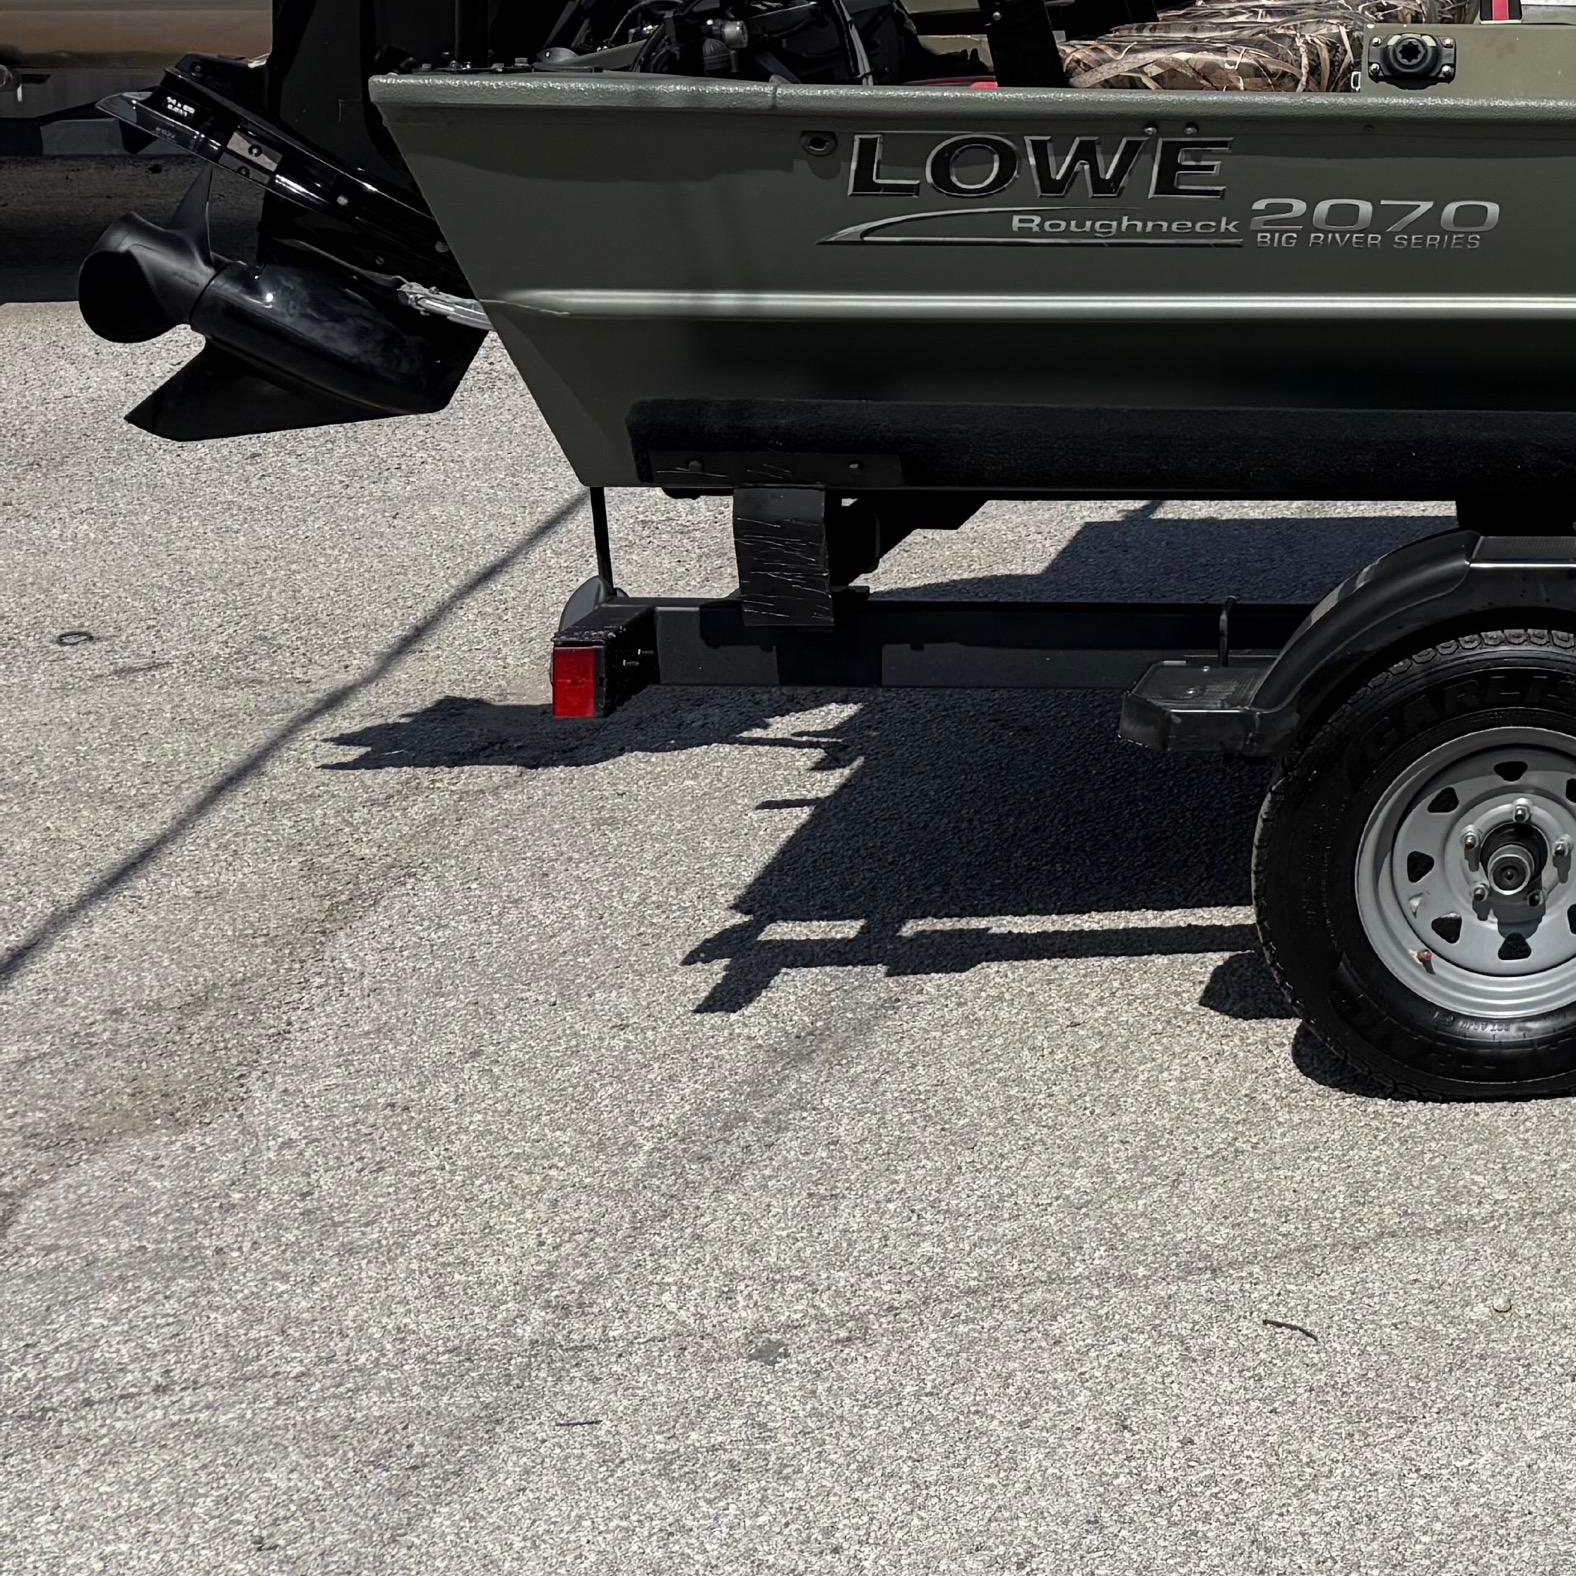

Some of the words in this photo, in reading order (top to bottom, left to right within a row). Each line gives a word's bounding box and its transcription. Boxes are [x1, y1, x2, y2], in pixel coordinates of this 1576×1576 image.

[848, 133, 1235, 199] LOWE
[1011, 214, 1241, 239] Roughneck
[1250, 198, 1501, 232] 2070
[1256, 232, 1297, 248] BIG
[1309, 232, 1382, 249] RIVER
[1392, 233, 1481, 250] SERIES
